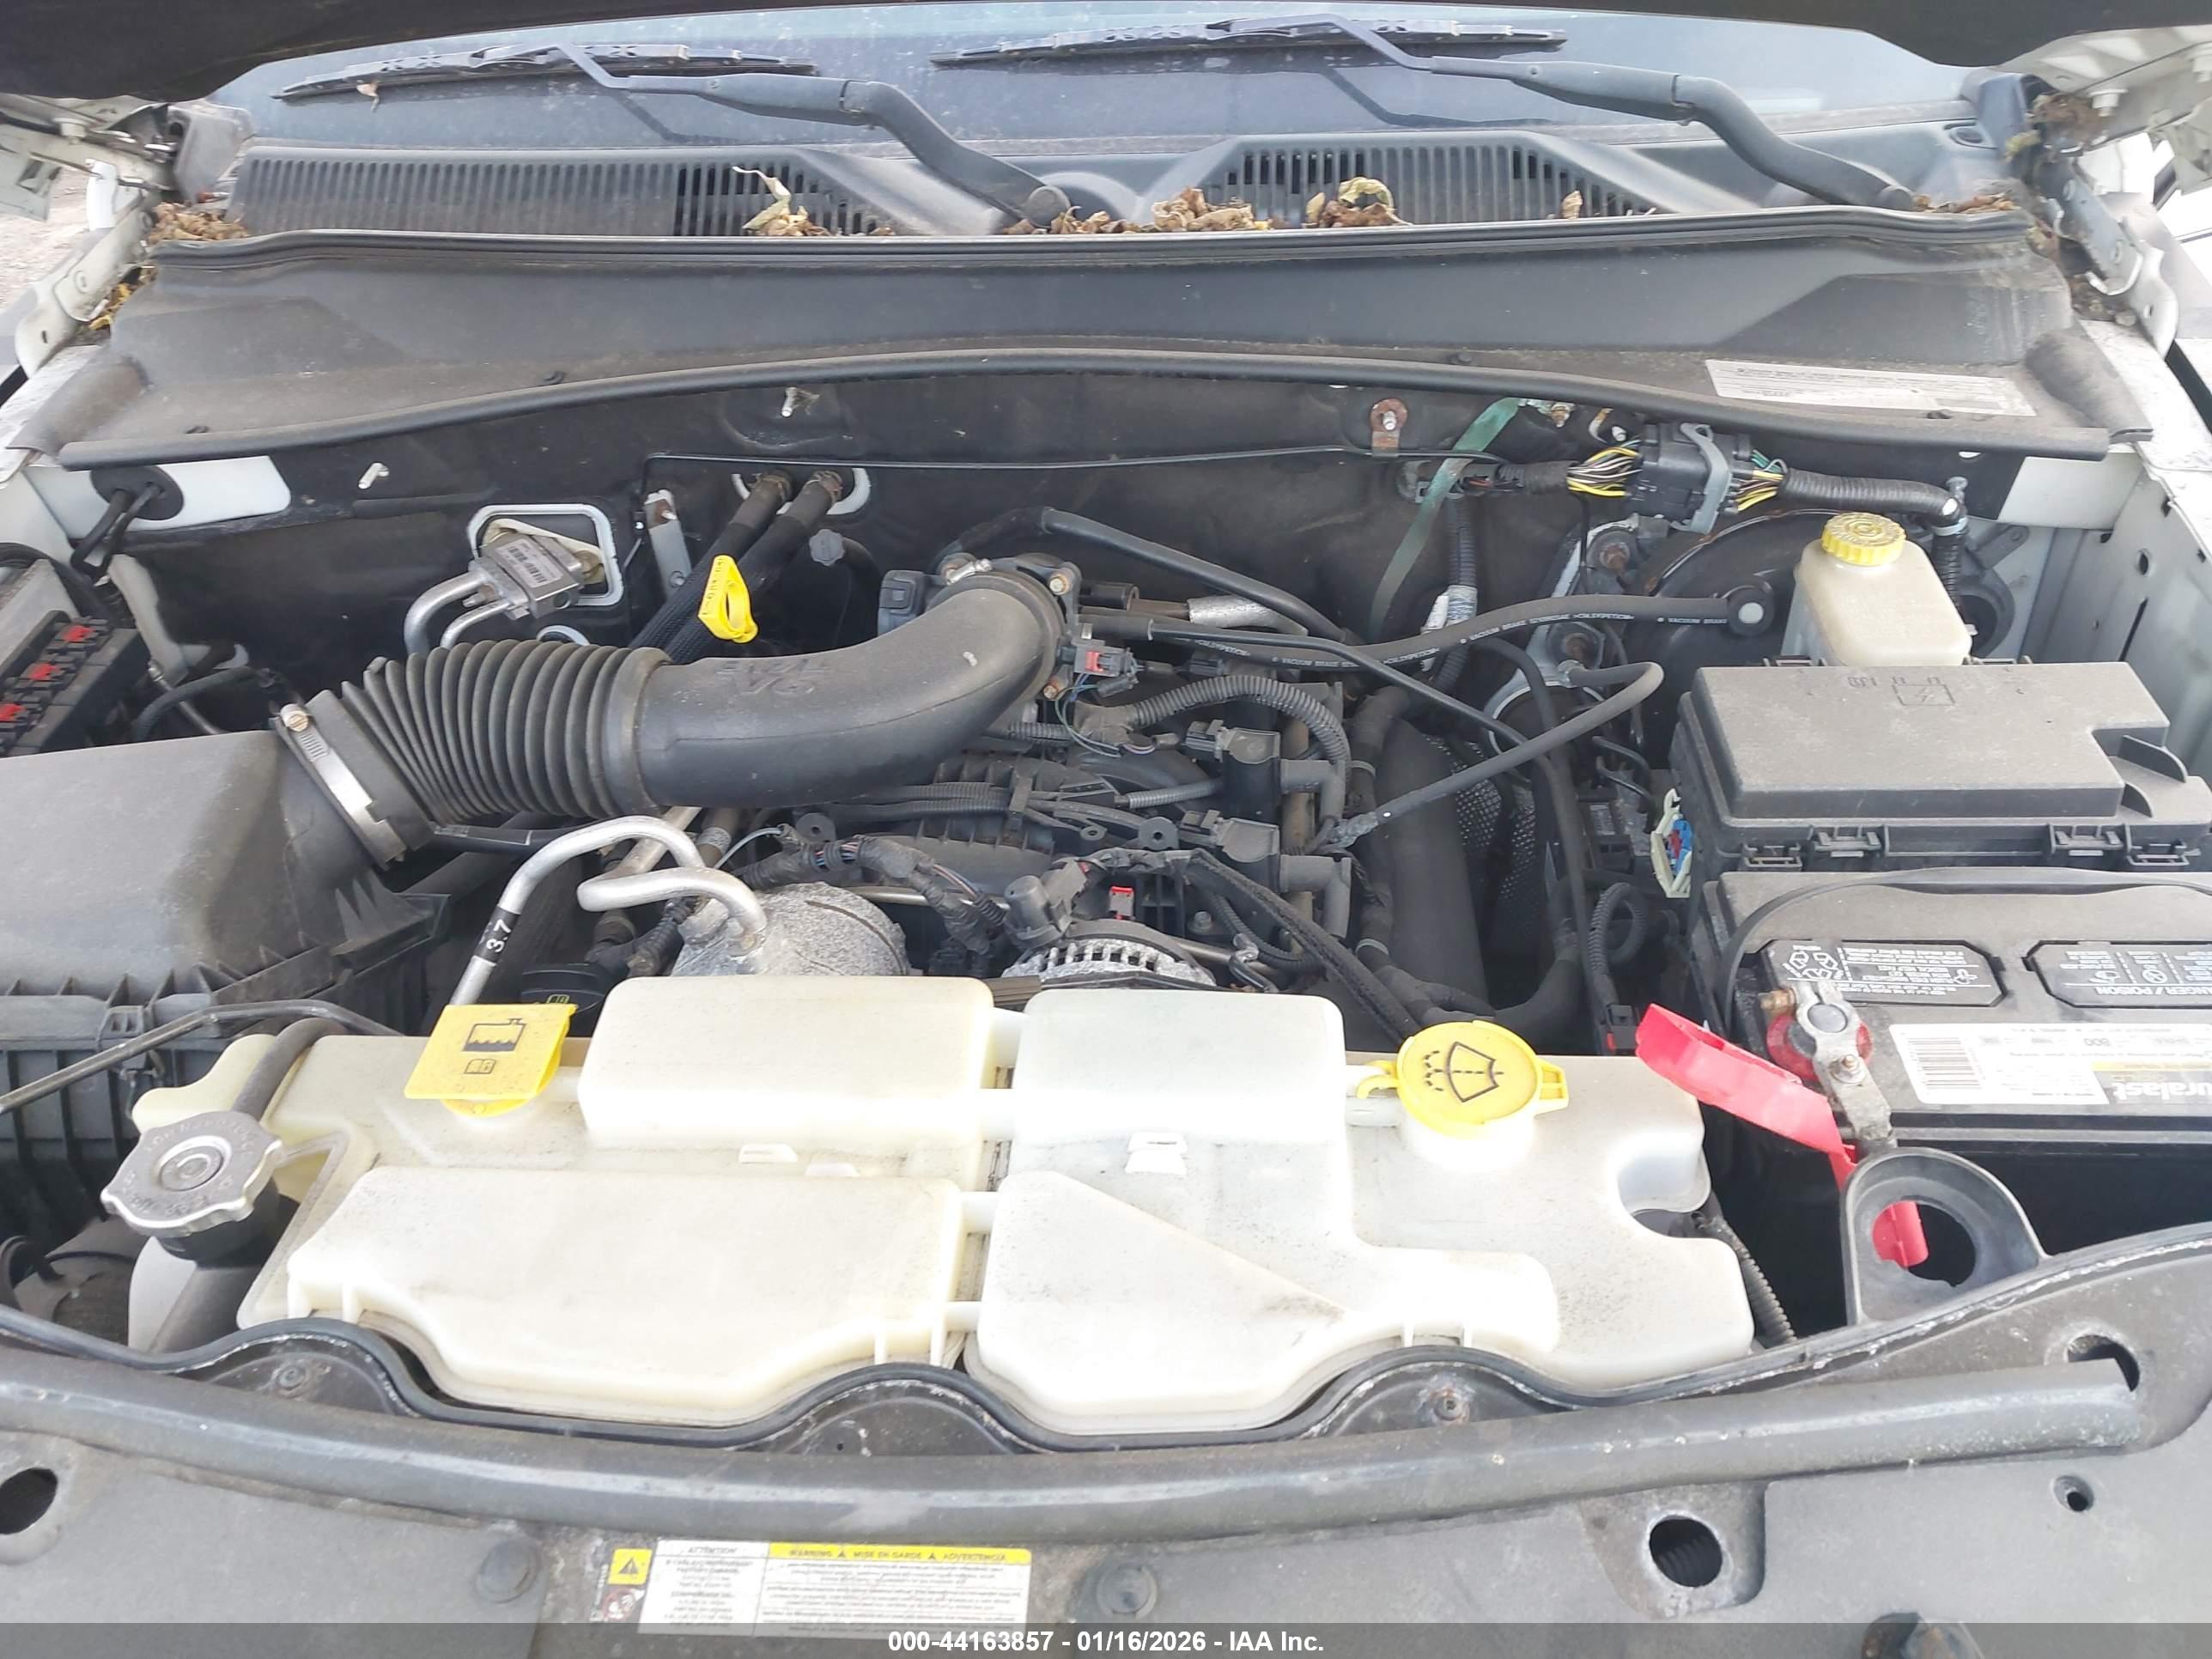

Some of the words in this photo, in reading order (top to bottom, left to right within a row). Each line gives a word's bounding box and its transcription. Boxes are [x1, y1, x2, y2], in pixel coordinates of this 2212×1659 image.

[486, 919, 513, 953] 3.7
[2094, 986, 2153, 995] POISON
[2164, 986, 2212, 995] ANGER
[2110, 1082, 2212, 1101] uralast
